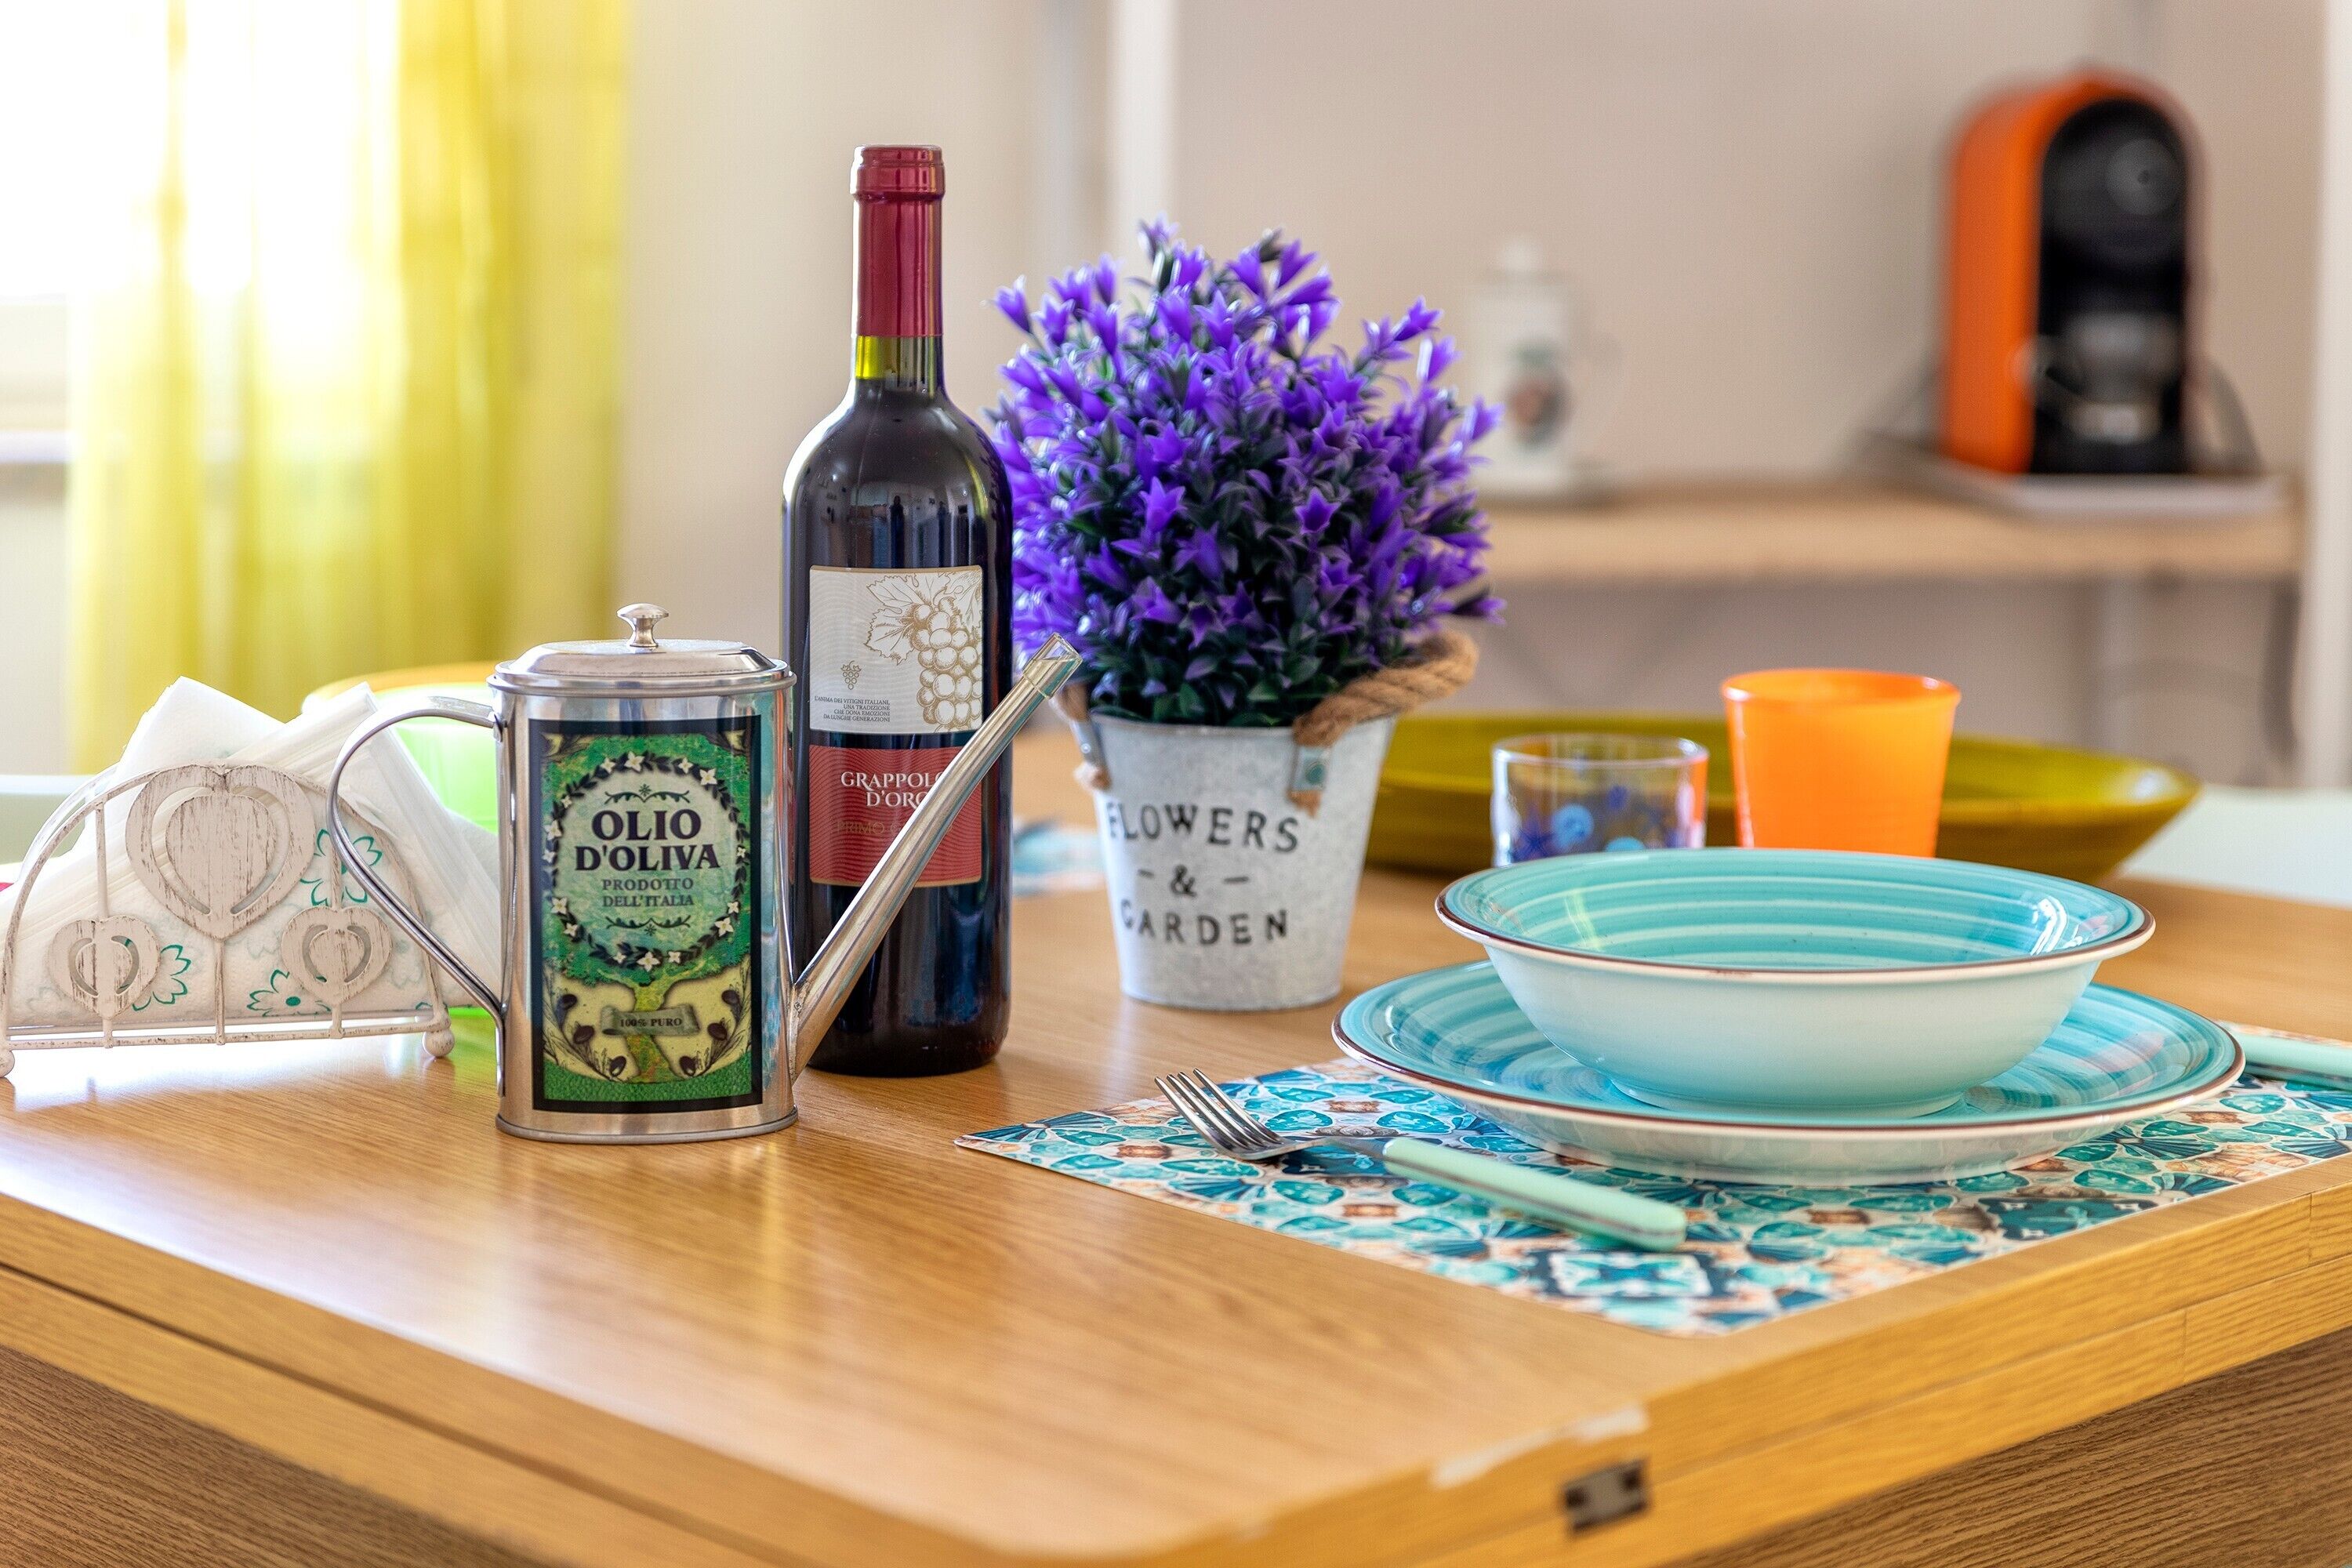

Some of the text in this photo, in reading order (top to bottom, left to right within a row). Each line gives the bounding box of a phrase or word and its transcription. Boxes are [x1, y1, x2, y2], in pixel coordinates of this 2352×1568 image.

[592, 808, 701, 840] OLIO
[1107, 801, 1298, 853] FLOWERS
[575, 844, 720, 871] D'OLIVA
[603, 877, 693, 891] PRODOTTO
[602, 894, 694, 907] DELL'ITALIA
[1120, 898, 1287, 945] GARDEN
[620, 1018, 682, 1028] 100% PURO
